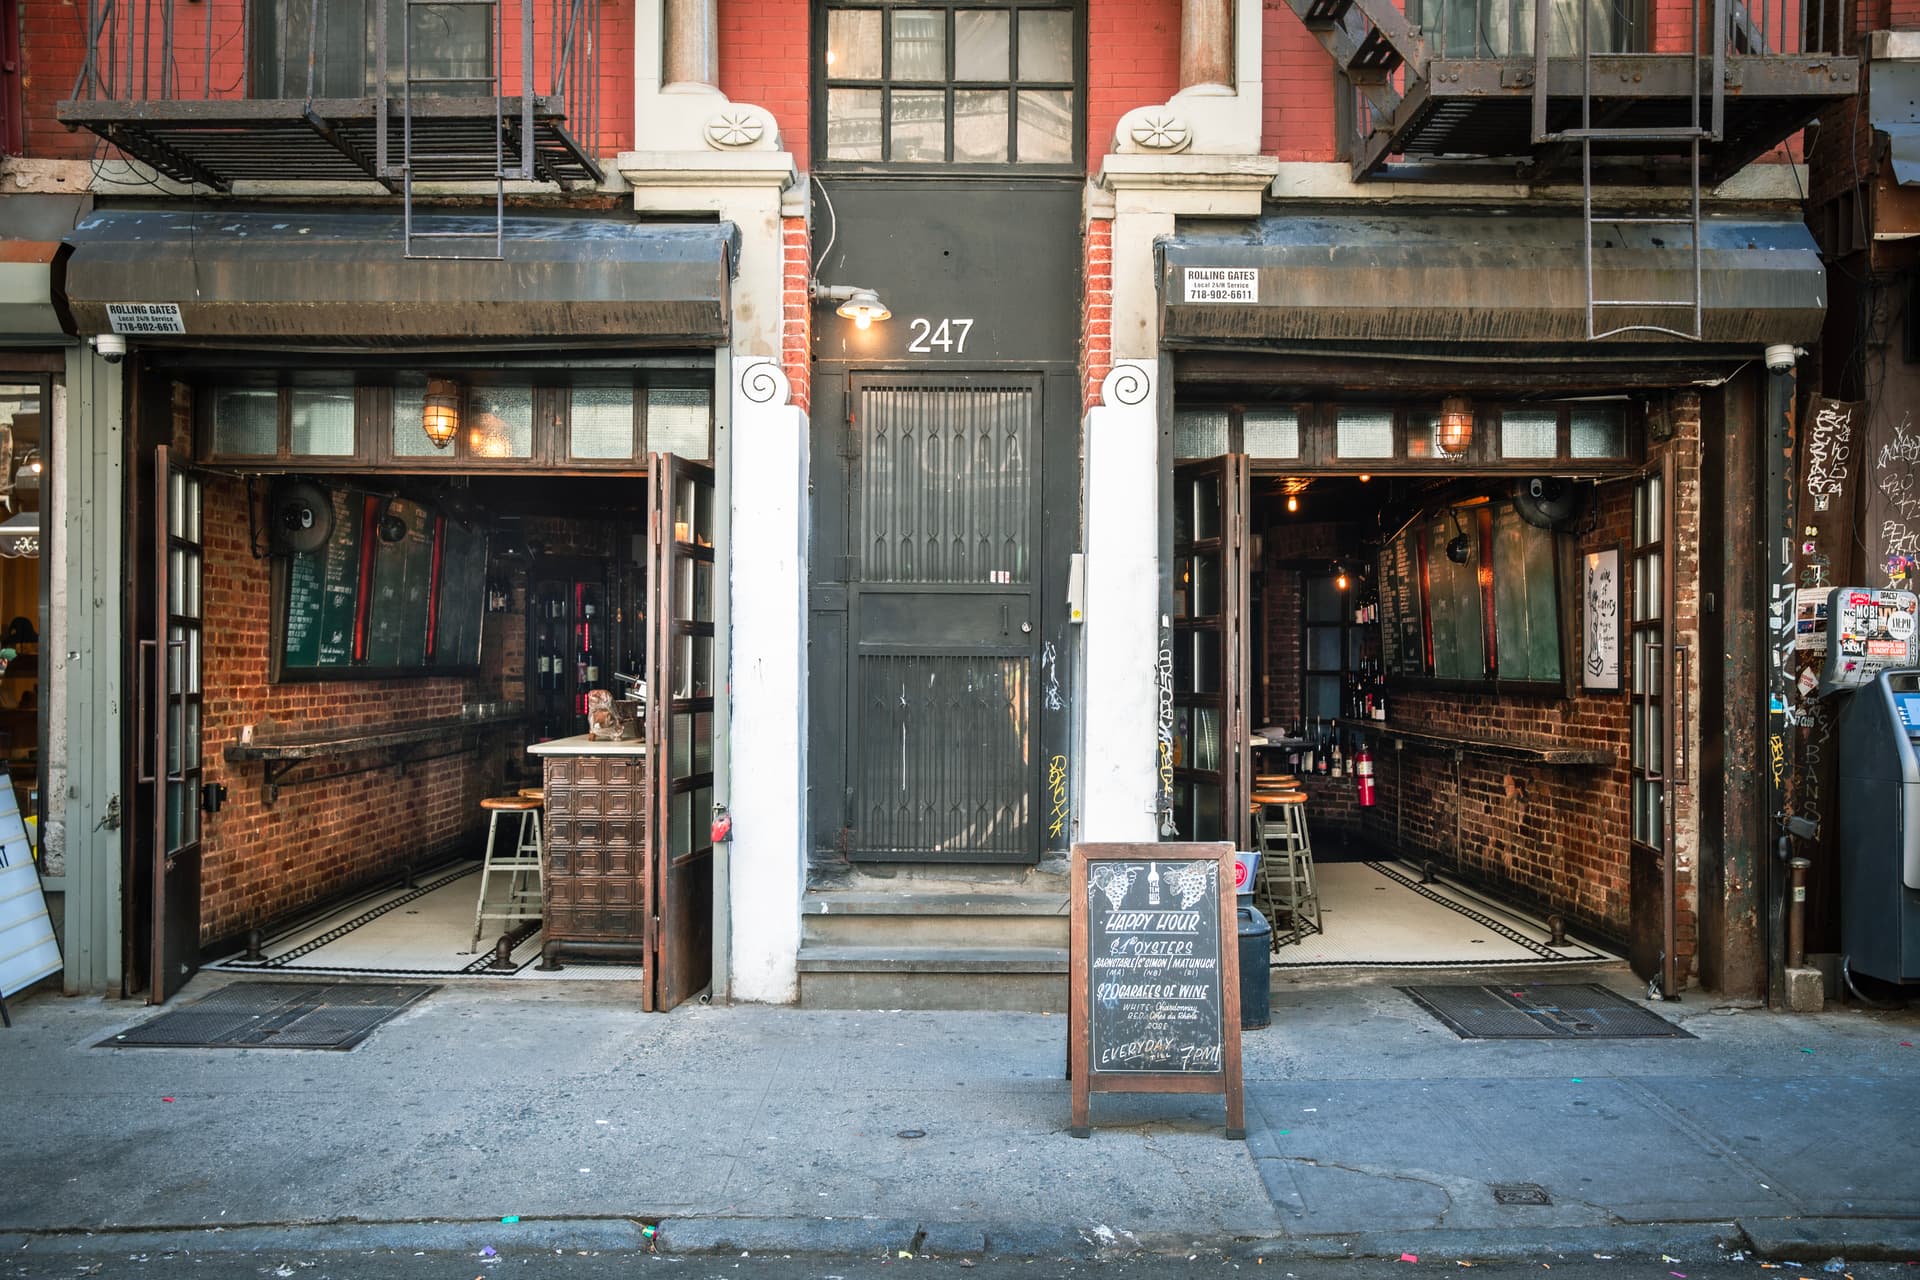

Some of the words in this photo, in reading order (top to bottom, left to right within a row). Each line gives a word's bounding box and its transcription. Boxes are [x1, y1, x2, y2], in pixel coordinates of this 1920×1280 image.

[1188, 270, 1225, 280] ROLLING
[1227, 271, 1255, 280] GATES
[1190, 290, 1252, 299] 718-902-6611
[109, 305, 148, 314] ROLLING
[149, 305, 178, 314] GATES
[116, 323, 179, 332] 718-902-6611
[908, 318, 974, 353] 247
[1105, 913, 1154, 931] HAPPY
[1155, 914, 1200, 931] HOUR
[1134, 940, 1193, 955] OYSTERS
[1178, 984, 1210, 1000] WINE
[1102, 1038, 1174, 1063] EVERYDAY
